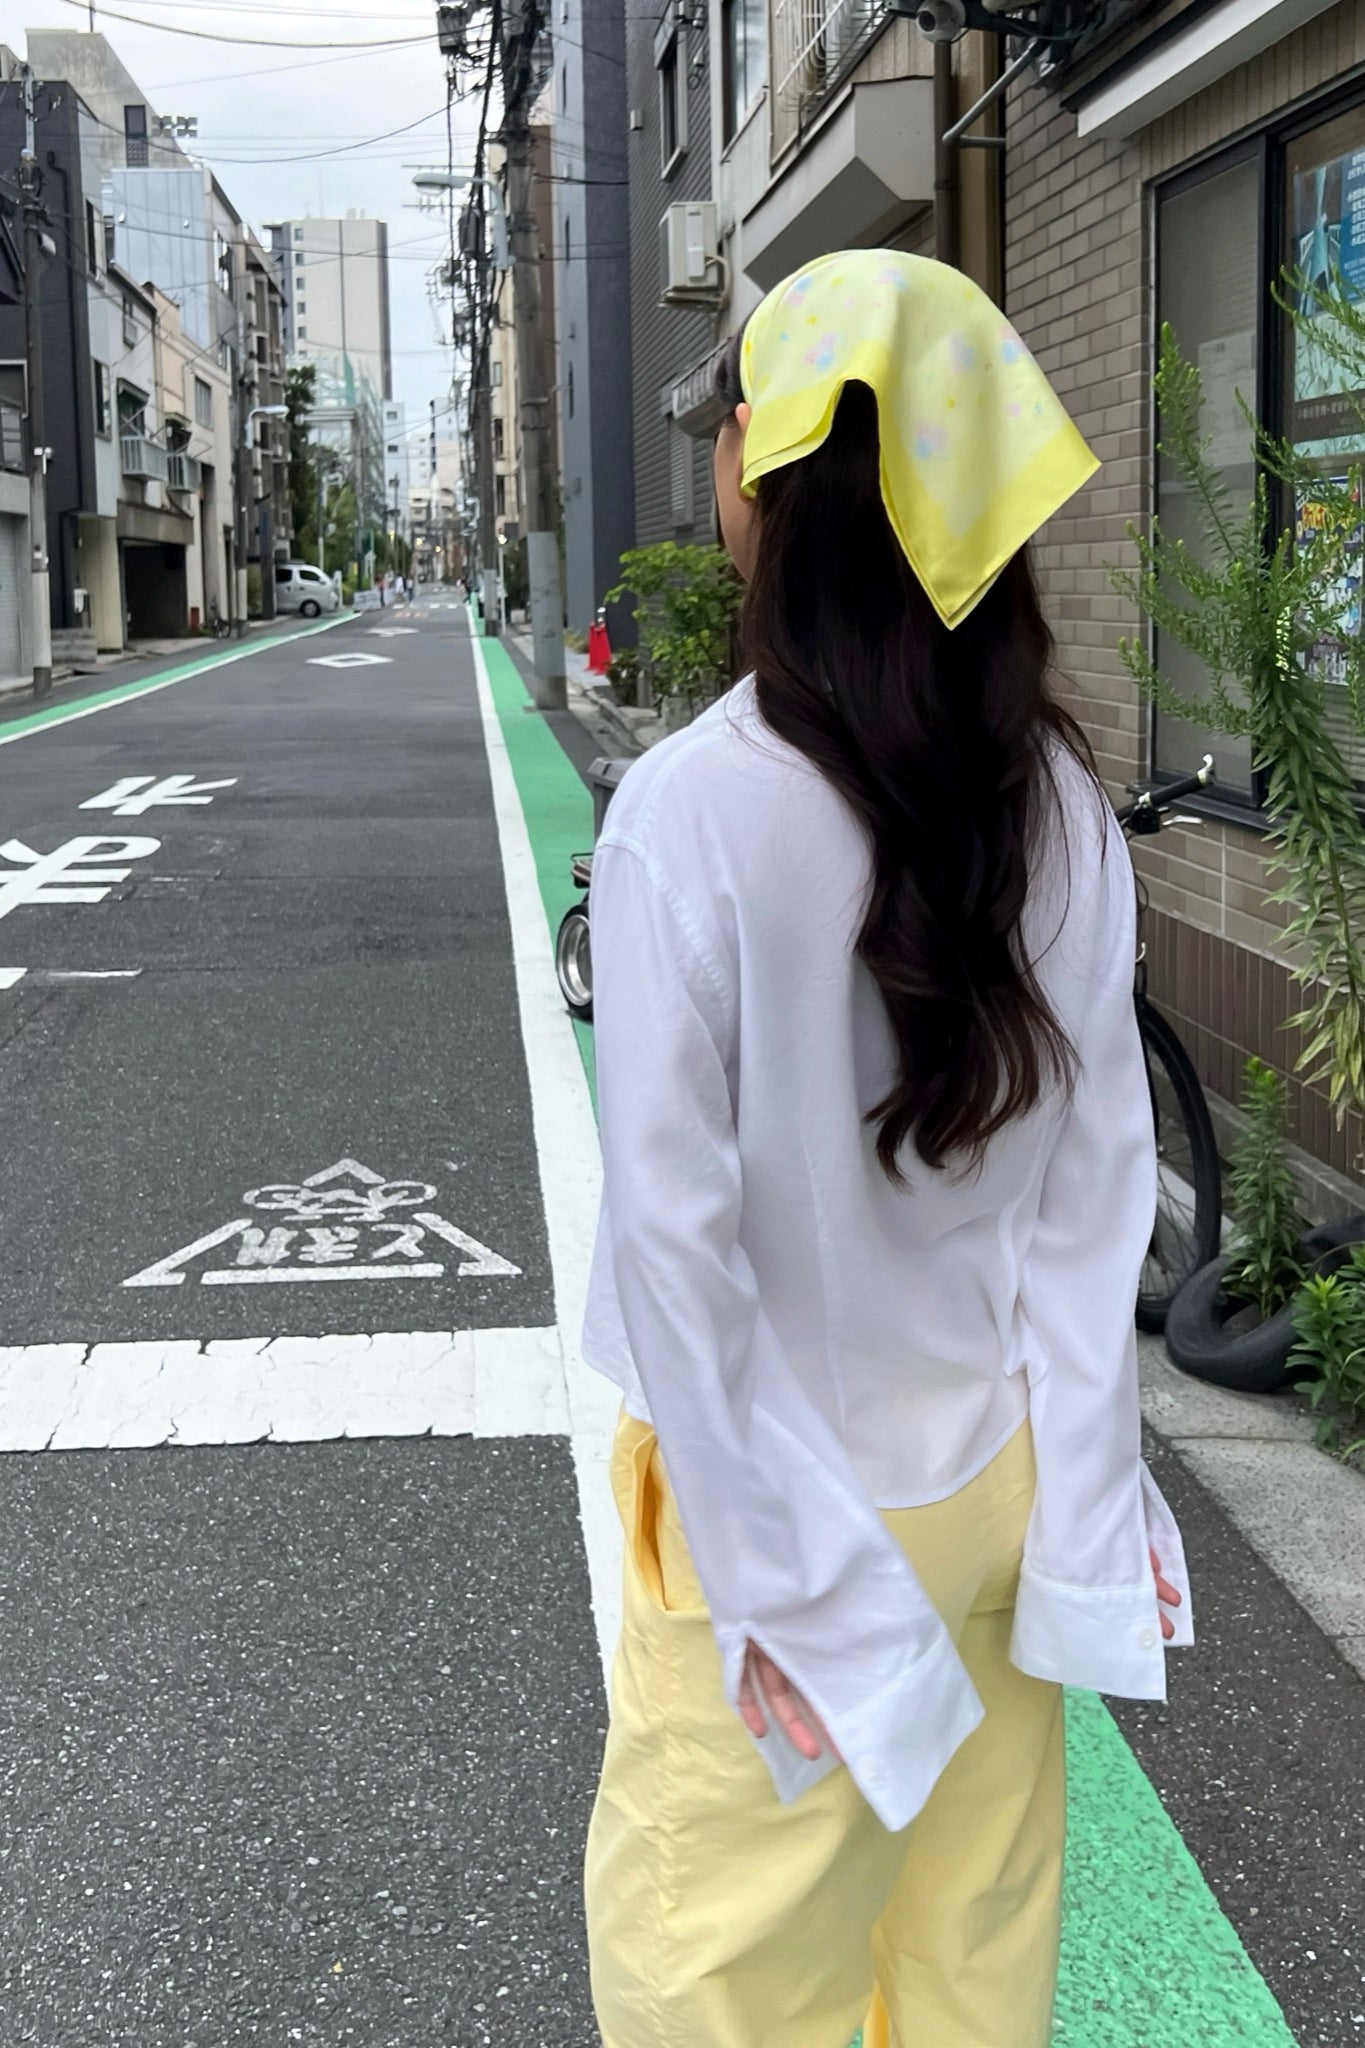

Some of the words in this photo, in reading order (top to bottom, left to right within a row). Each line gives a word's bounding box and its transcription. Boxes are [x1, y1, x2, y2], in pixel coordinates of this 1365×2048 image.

[0, 774, 238, 989] まれ
[235, 1224, 425, 1266] とまれ
